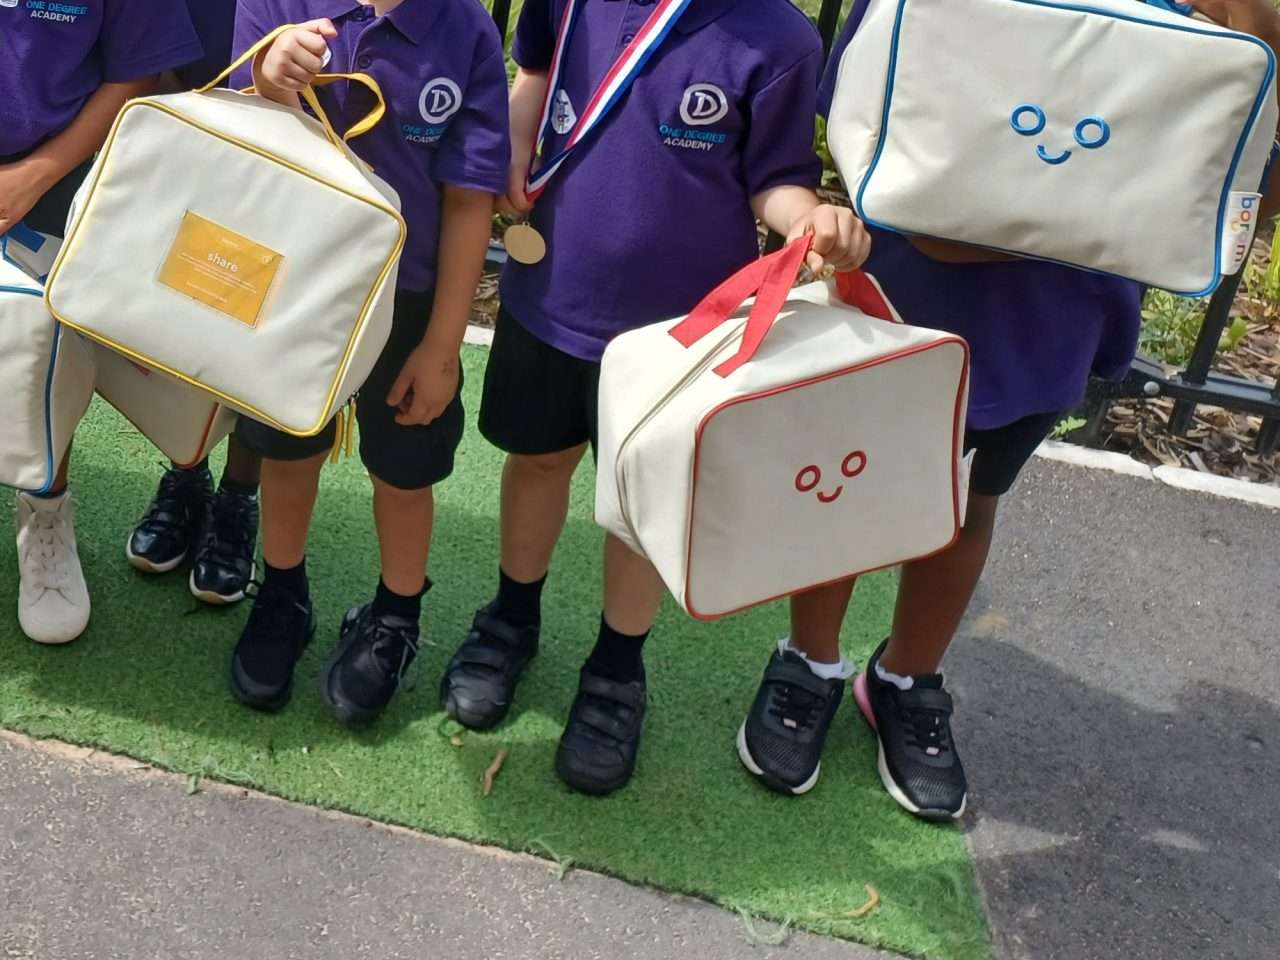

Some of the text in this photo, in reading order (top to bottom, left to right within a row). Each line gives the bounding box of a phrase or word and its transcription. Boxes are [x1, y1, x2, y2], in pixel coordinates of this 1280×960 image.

[26, 0, 88, 16] ONE DEGREE
[30, 9, 78, 24] ACADEMY
[659, 124, 682, 138] ONE
[663, 136, 715, 152] ACADEMY
[207, 252, 238, 273] share
